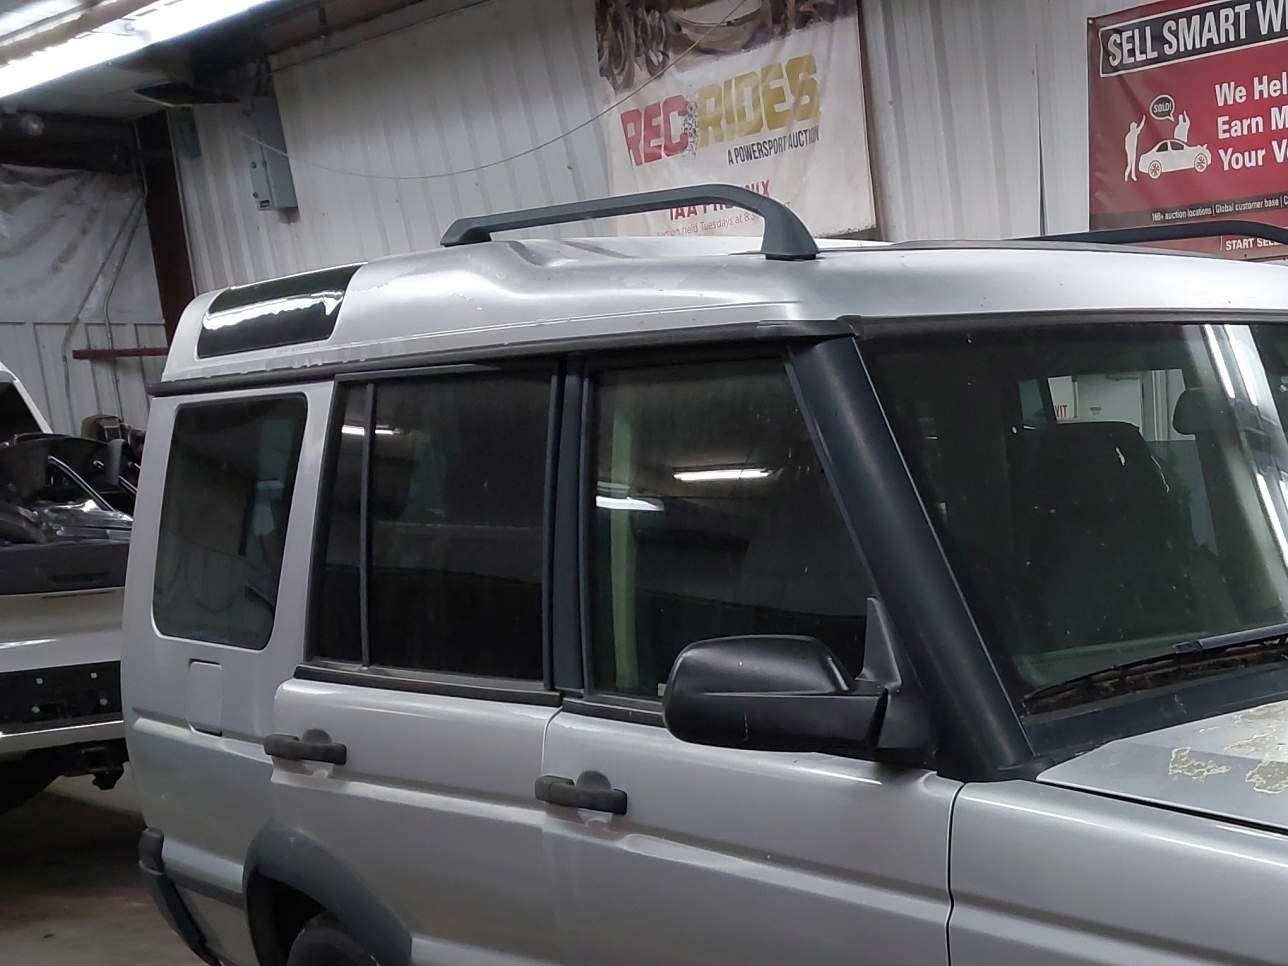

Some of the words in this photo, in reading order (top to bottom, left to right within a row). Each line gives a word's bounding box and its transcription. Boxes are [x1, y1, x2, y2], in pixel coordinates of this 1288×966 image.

[1108, 28, 1158, 67] SELL
[1162, 6, 1251, 55] SMART
[1215, 81, 1247, 107] We
[620, 94, 689, 166] REC
[696, 54, 821, 146] RIDES
[1153, 102, 1172, 113] SOLD!
[1217, 115, 1264, 139] Earn
[727, 149, 734, 167] A
[734, 136, 787, 164] POWERSPORT
[787, 125, 820, 150] AUCTION
[1218, 147, 1266, 171] Your
[1165, 208, 1187, 220] auction
[1187, 204, 1213, 217] locations
[1215, 202, 1235, 213] Global
[1235, 199, 1264, 212] customer
[1264, 197, 1279, 208] base
[1226, 238, 1254, 250] START
